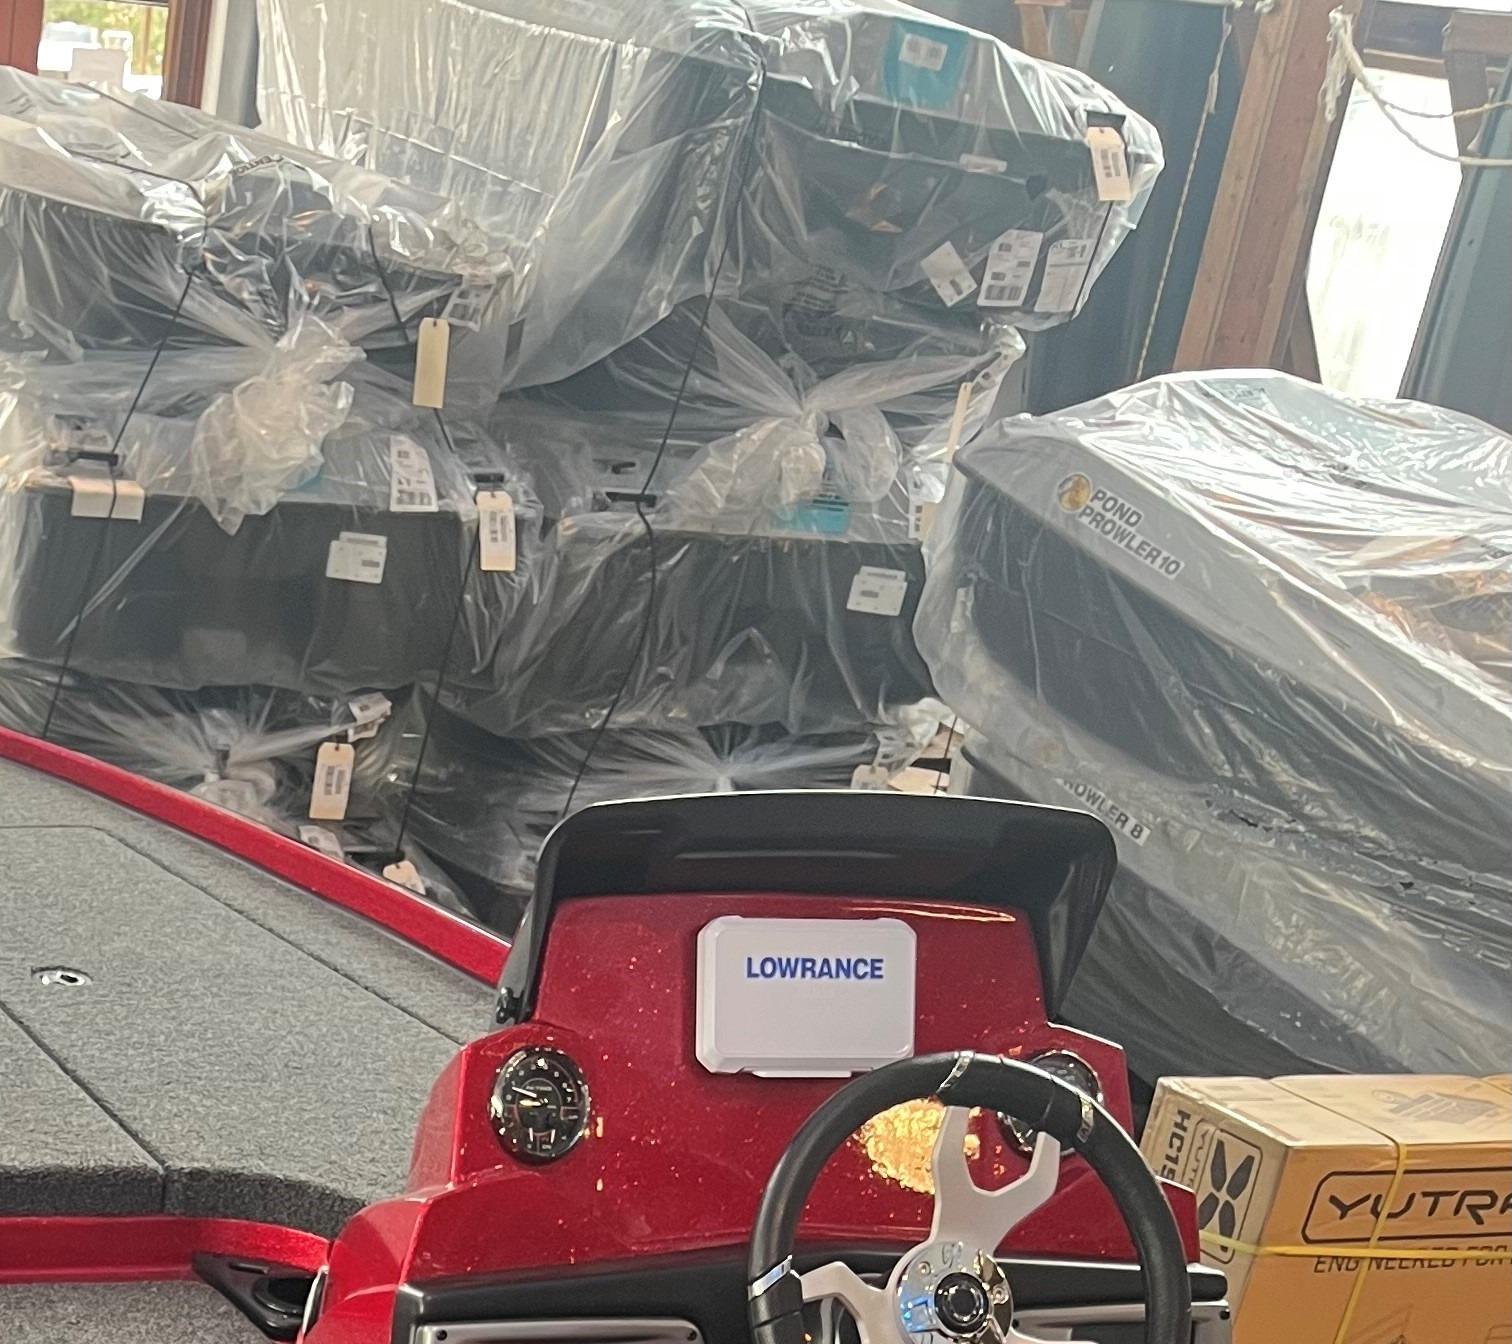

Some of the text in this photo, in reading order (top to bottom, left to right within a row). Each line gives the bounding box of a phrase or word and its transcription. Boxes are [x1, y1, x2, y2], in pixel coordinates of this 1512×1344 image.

[1090, 489, 1143, 528] POND
[1078, 505, 1181, 576] PROWLER 10
[1130, 823, 1144, 840] 8
[746, 956, 884, 980] LOWRANCE
[1313, 1246, 1457, 1273] ENGNEERED
